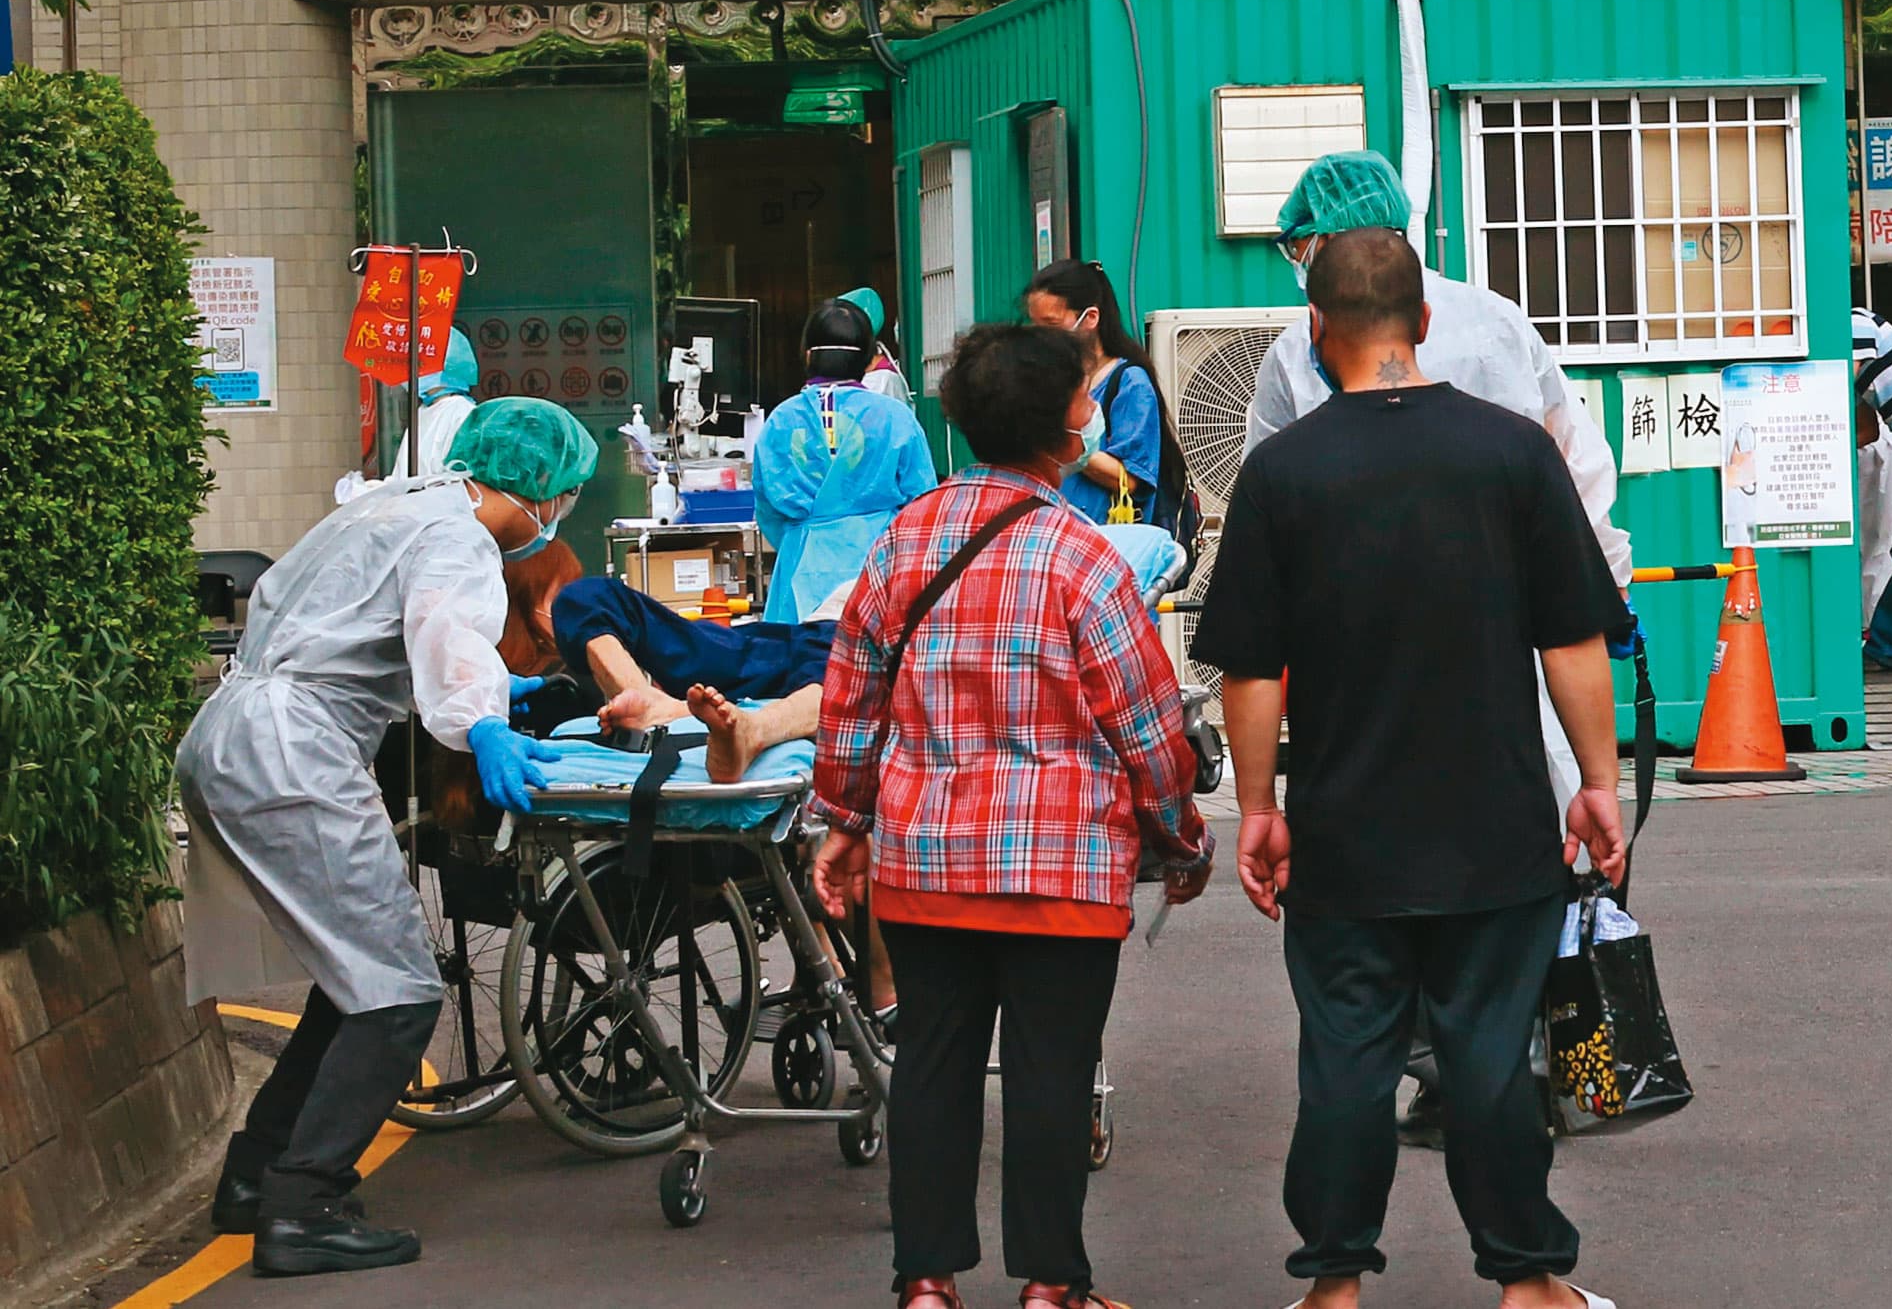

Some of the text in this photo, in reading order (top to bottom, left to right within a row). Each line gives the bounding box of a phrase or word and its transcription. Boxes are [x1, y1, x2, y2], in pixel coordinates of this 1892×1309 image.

[230, 315, 256, 325] code
[381, 321, 432, 339] 愛惜用
[1762, 373, 1802, 393] 注意
